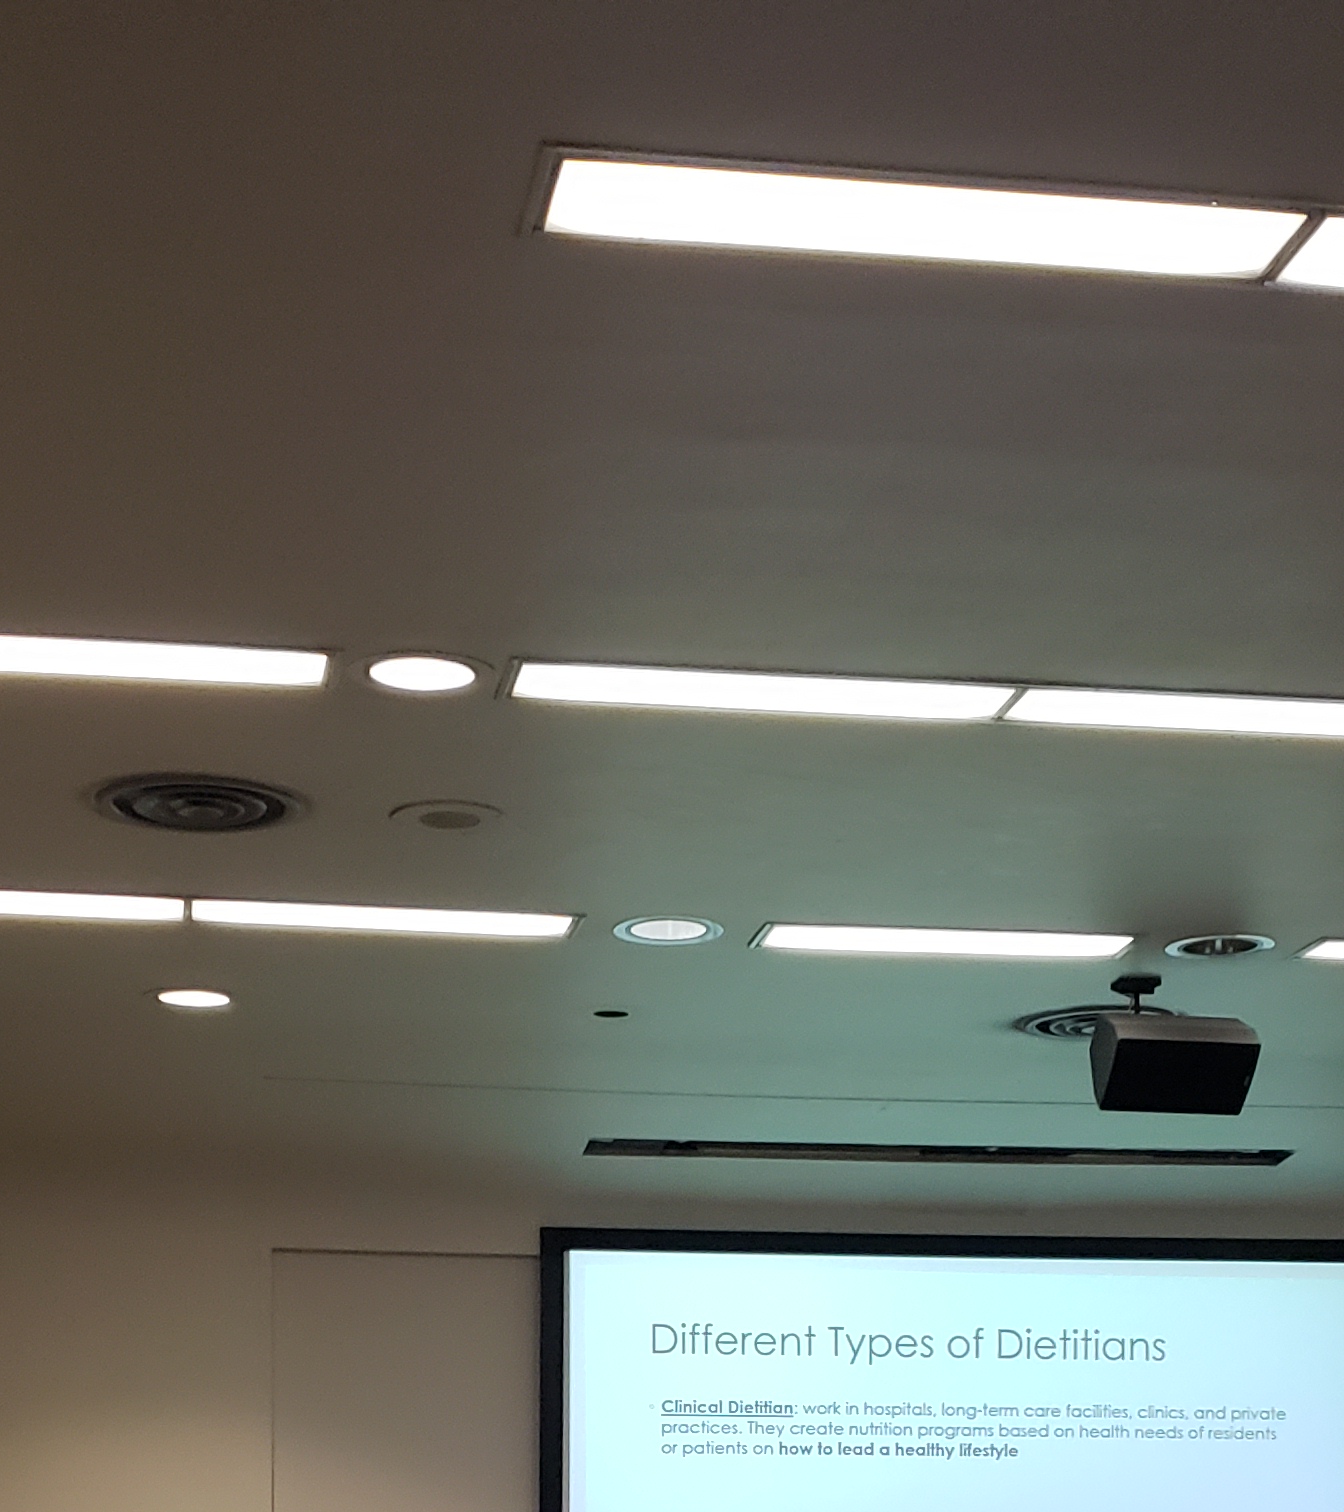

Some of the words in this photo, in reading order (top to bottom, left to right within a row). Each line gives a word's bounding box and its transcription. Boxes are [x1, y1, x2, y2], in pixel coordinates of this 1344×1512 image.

[652, 1323, 816, 1356] Different
[827, 1327, 934, 1365] Types
[947, 1327, 984, 1359] of
[997, 1328, 1166, 1361] Dietitians
[661, 1400, 725, 1417] Clinical
[727, 1400, 798, 1418] Dietitian:
[803, 1402, 841, 1415] work
[846, 1402, 859, 1415] in
[864, 1402, 937, 1418] hospitals,
[942, 1403, 1019, 1420] long-term
[1024, 1407, 1061, 1417] care
[1066, 1404, 1132, 1419] facilities,
[1137, 1405, 1189, 1420] clinics,
[1194, 1406, 1226, 1419] and
[1230, 1407, 1286, 1423] private
[662, 1421, 742, 1437] practices.
[747, 1421, 785, 1438] They
[790, 1422, 844, 1435] create
[849, 1422, 913, 1436] nutrition
[918, 1426, 994, 1440] programs
[999, 1424, 1049, 1437] based
[1054, 1428, 1074, 1438] on
[1079, 1425, 1130, 1438] health
[1135, 1426, 1184, 1439] needs
[1188, 1426, 1205, 1439] of
[1207, 1426, 1277, 1440] residents
[661, 1444, 678, 1454] or
[683, 1441, 748, 1457] patients
[753, 1445, 774, 1455] on
[779, 1441, 813, 1455] how
[817, 1442, 833, 1455] to
[838, 1442, 874, 1455] lead
[879, 1446, 890, 1456] a
[895, 1442, 955, 1460] healthy
[959, 1443, 1018, 1460] lifestyle
